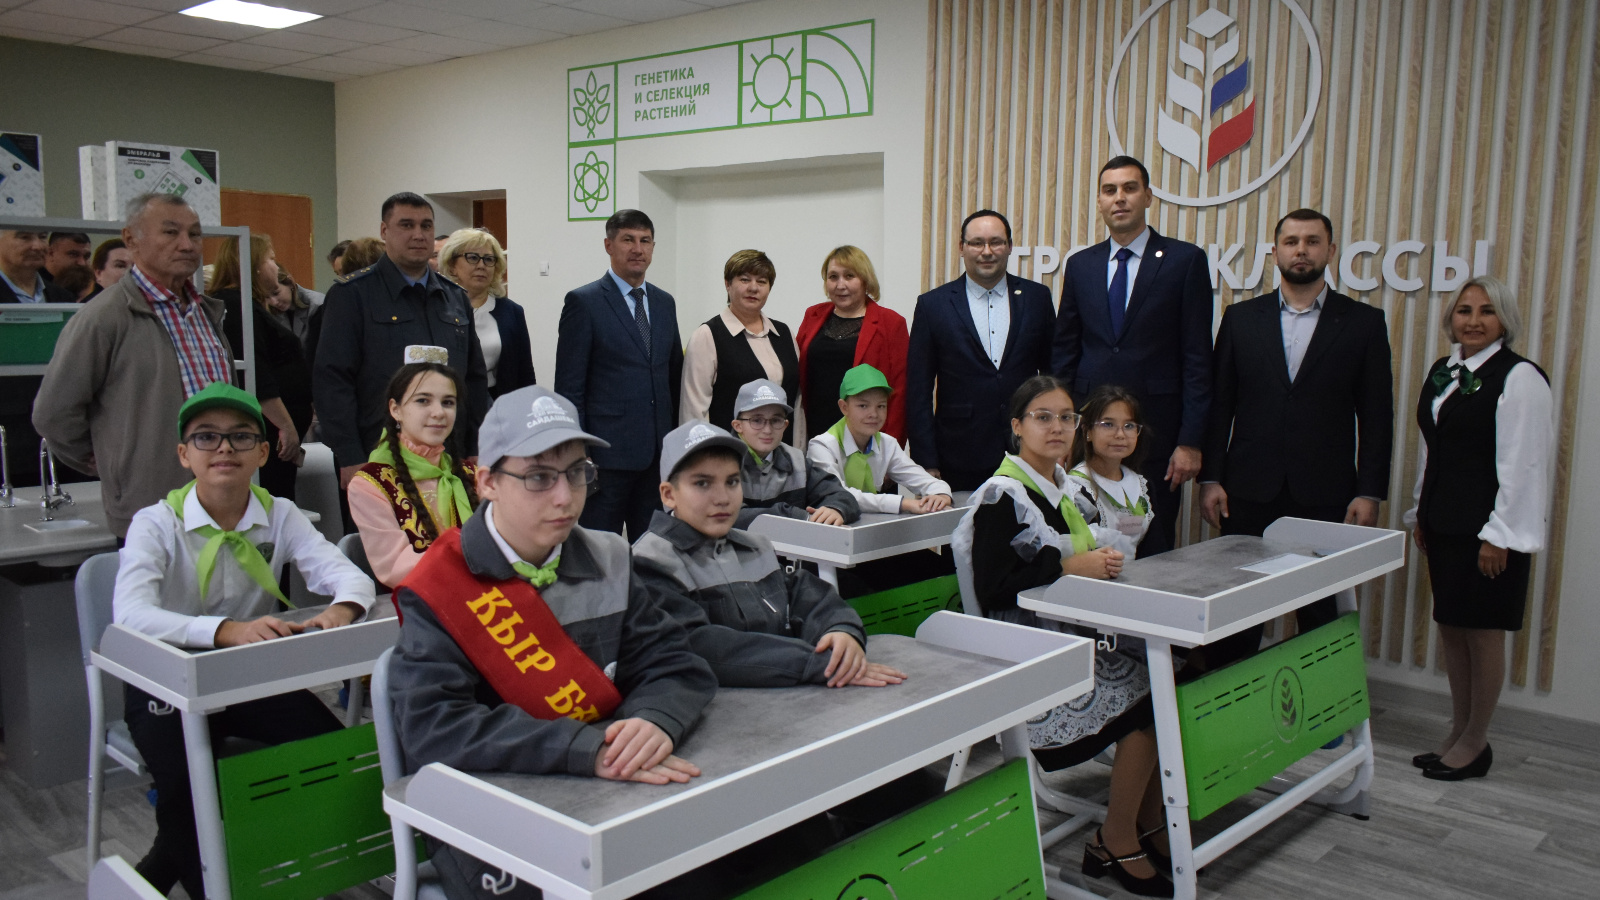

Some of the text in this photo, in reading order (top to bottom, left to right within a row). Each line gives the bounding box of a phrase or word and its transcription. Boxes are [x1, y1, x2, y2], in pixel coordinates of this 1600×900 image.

[634, 66, 695, 87] ГЕНЕТИКА
[634, 82, 710, 105] И СЕЛЕКЦИЯ
[634, 99, 697, 122] РАСТЕНИЙ
[126, 149, 161, 158] ЭМЕРАЛЬД
[526, 414, 576, 429] САЙДАШЕВА
[465, 586, 556, 674] КЫР
